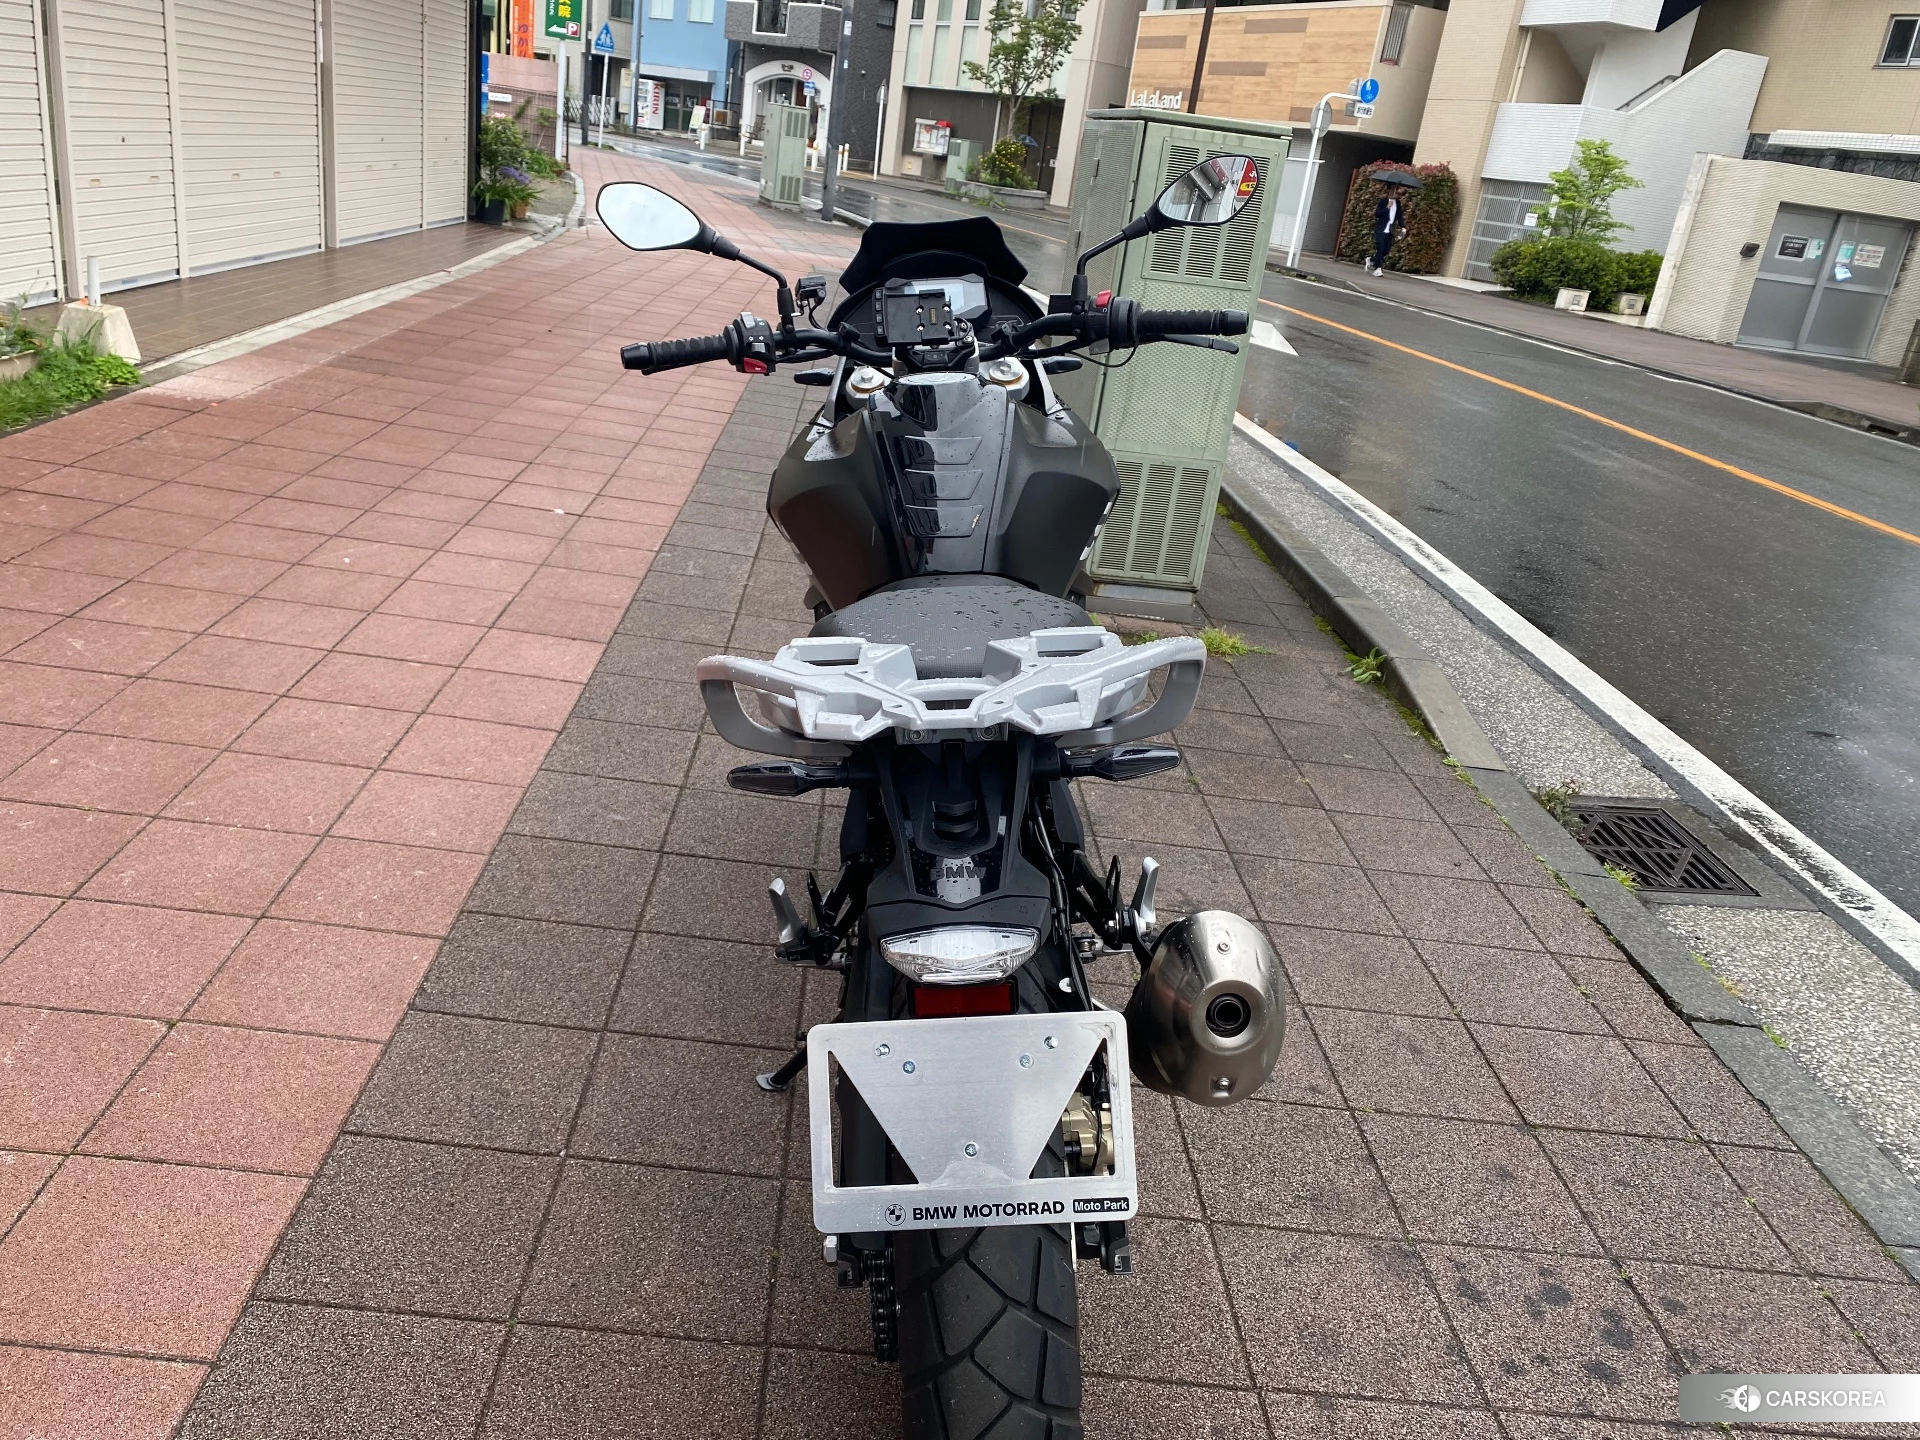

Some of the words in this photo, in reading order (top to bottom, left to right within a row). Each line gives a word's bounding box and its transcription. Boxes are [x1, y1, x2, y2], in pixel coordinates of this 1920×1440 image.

[652, 83, 661, 115] KIRIN
[1130, 89, 1183, 110] LaLaLand
[930, 866, 987, 881] BMW
[912, 1204, 958, 1221] BMW
[963, 1201, 1065, 1219] MOTORRAD
[1074, 1201, 1101, 1212] Moto
[1103, 1199, 1128, 1211] Park
